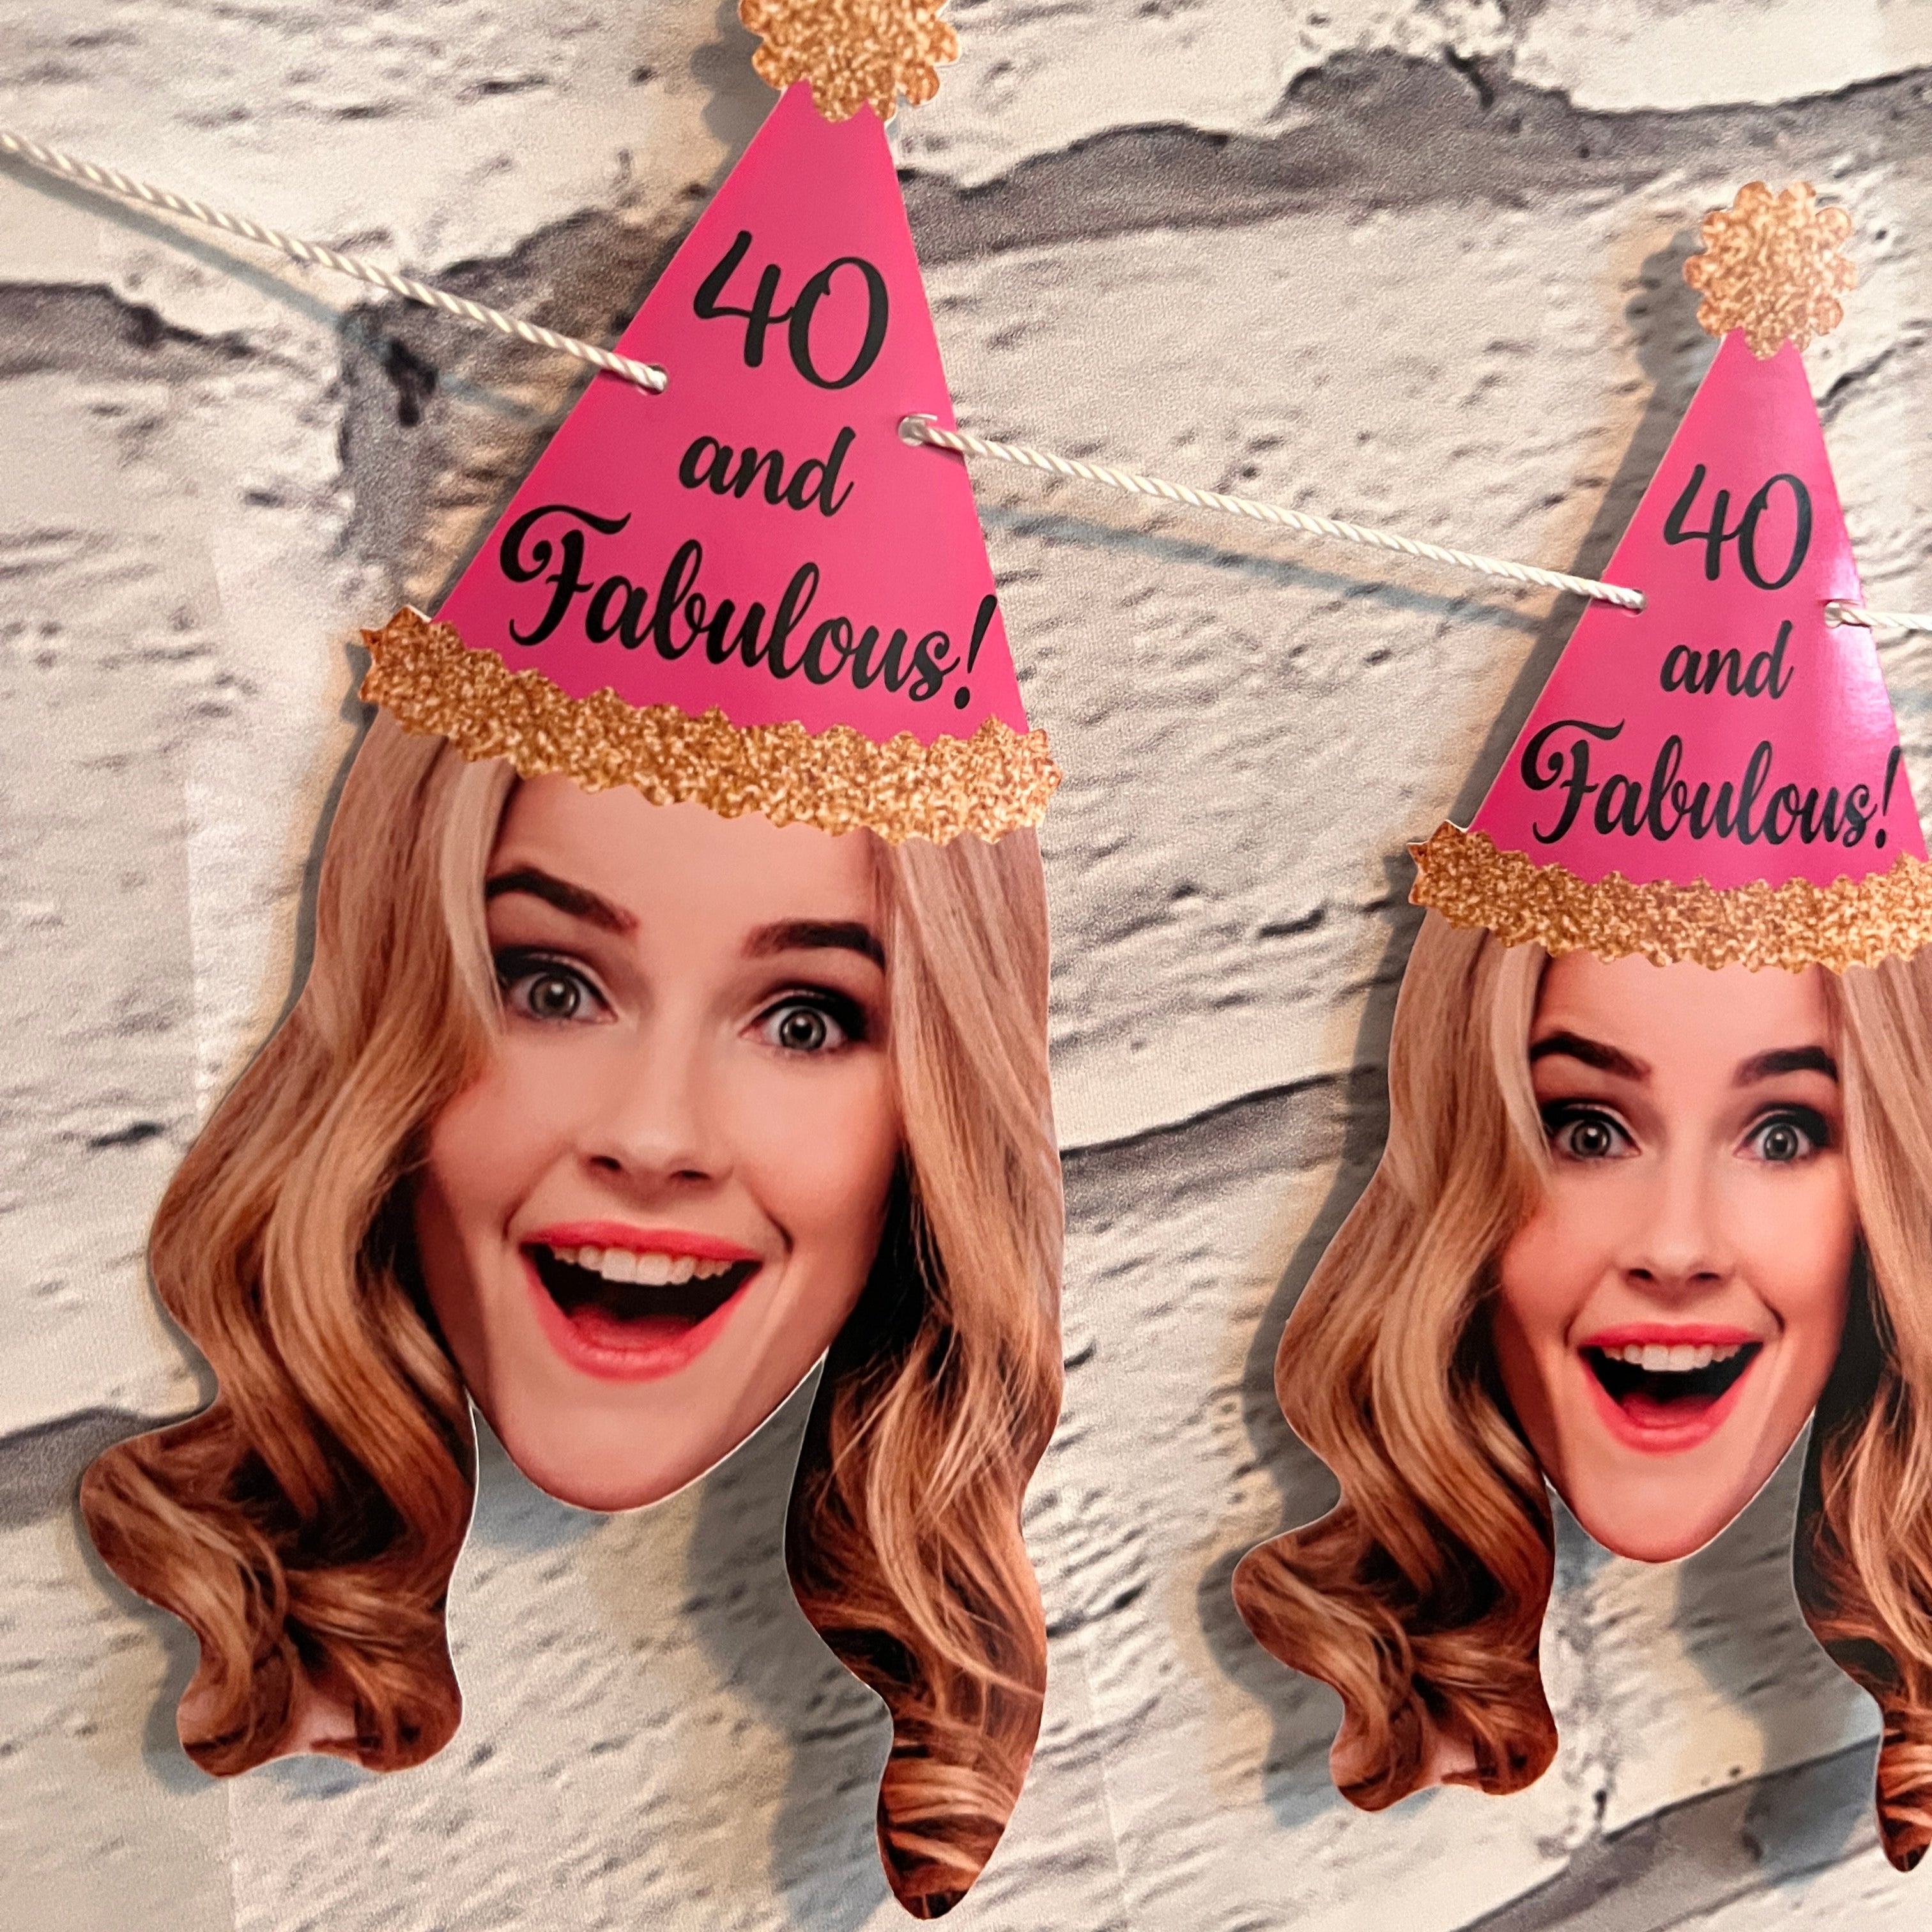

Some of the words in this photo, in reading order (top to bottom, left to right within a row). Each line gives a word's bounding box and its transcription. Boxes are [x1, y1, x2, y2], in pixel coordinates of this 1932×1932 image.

[693, 230, 889, 390] 40
[678, 427, 855, 517] and
[1664, 464, 1812, 590] 40
[499, 505, 998, 710] Fabulous!
[1660, 620, 1794, 699] and
[1521, 719, 1901, 848] Fabulous!
